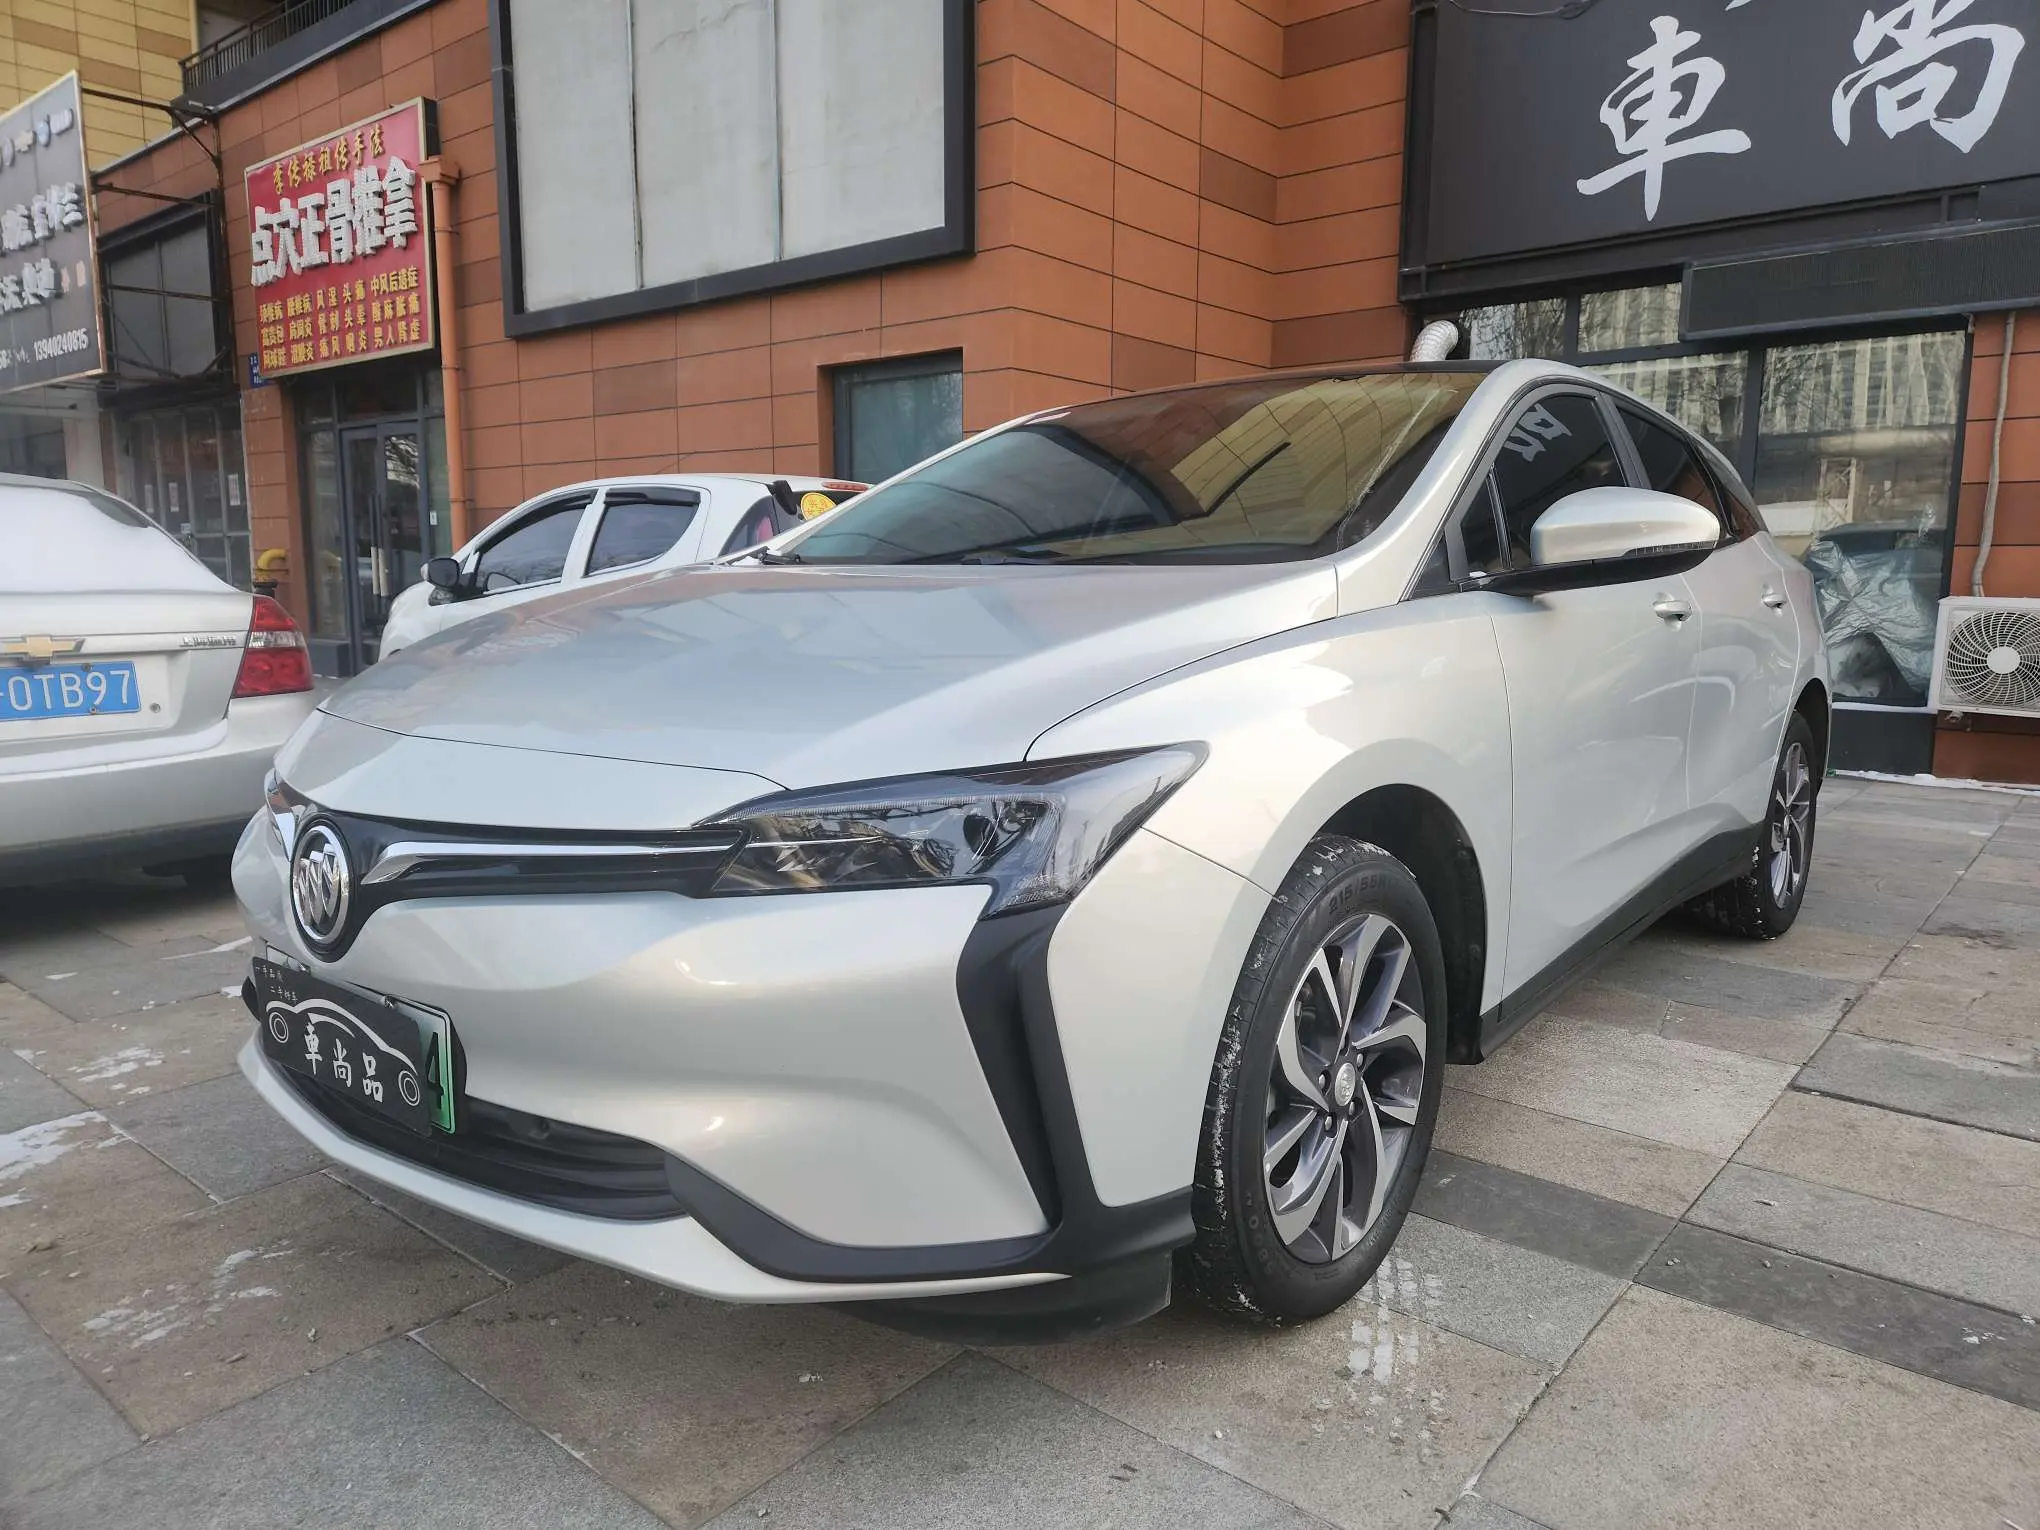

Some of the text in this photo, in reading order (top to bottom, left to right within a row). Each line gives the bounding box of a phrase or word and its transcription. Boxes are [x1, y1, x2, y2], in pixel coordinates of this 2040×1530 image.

[251, 155, 418, 287] 点穴正骨推拿
[370, 266, 419, 297] 中风后遗症
